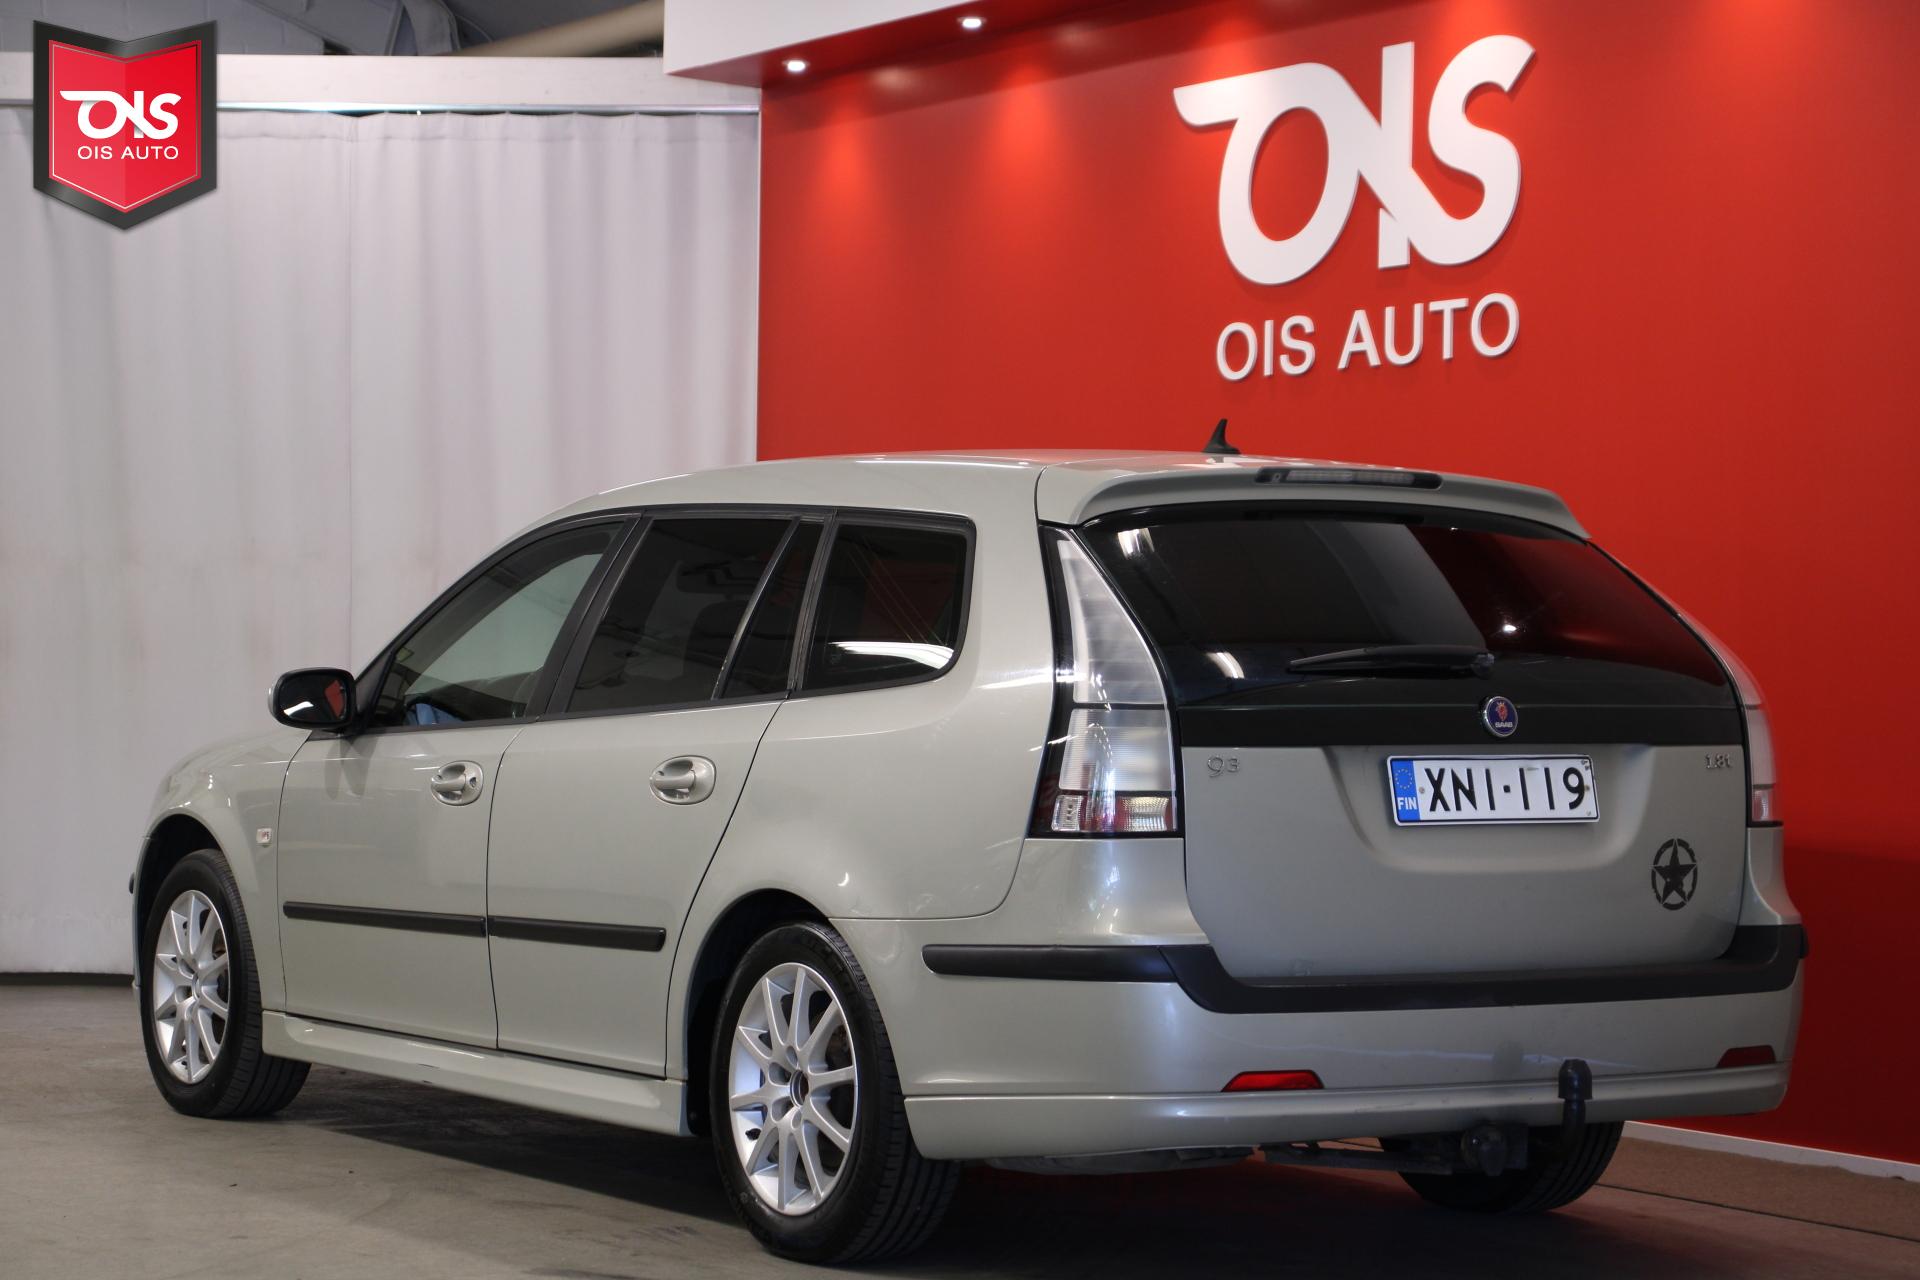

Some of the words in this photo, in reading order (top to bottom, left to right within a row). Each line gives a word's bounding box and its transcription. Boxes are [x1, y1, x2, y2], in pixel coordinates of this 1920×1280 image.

[1173, 34, 1536, 285] OIS
[1216, 315, 1316, 381] OIS
[1337, 292, 1521, 370] AUTO
[1397, 796, 1418, 811] FIN
